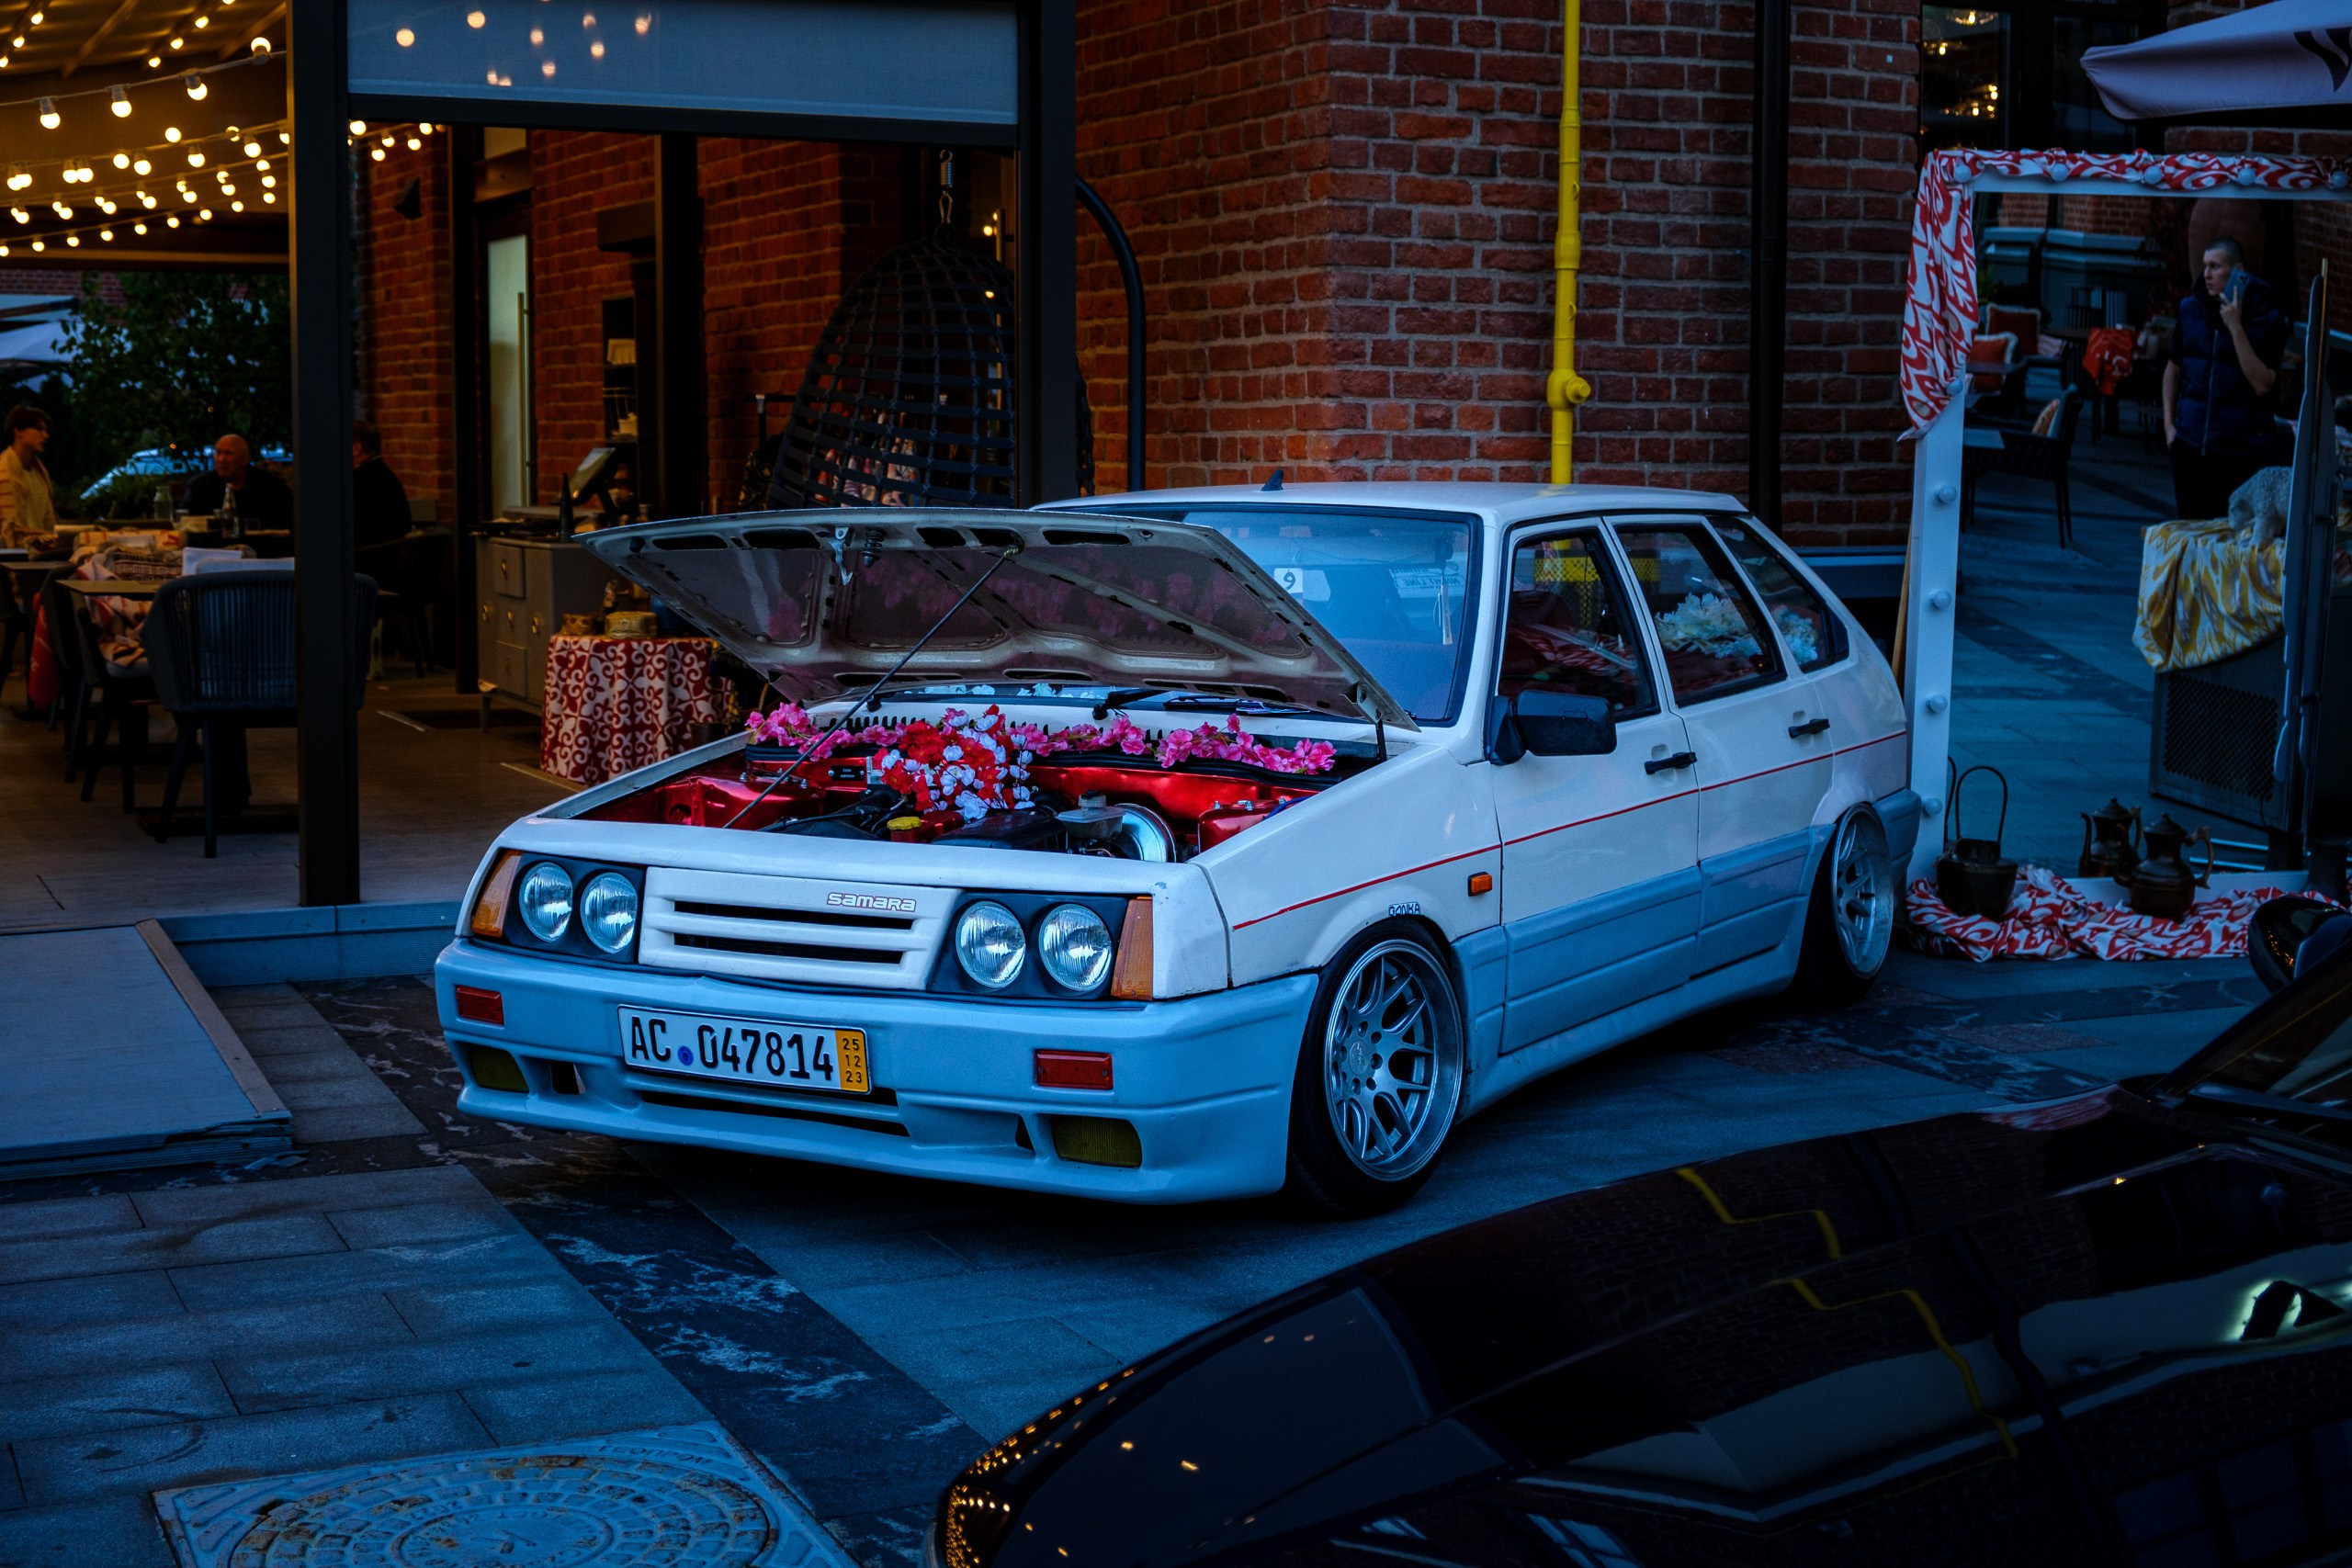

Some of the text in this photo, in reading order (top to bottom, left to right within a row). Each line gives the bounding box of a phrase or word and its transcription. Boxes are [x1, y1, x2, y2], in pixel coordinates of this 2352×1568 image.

[631, 1016, 834, 1081] AC 047814
[842, 1038, 860, 1051] 25
[845, 1055, 862, 1067] 12
[845, 1070, 864, 1083] 23
